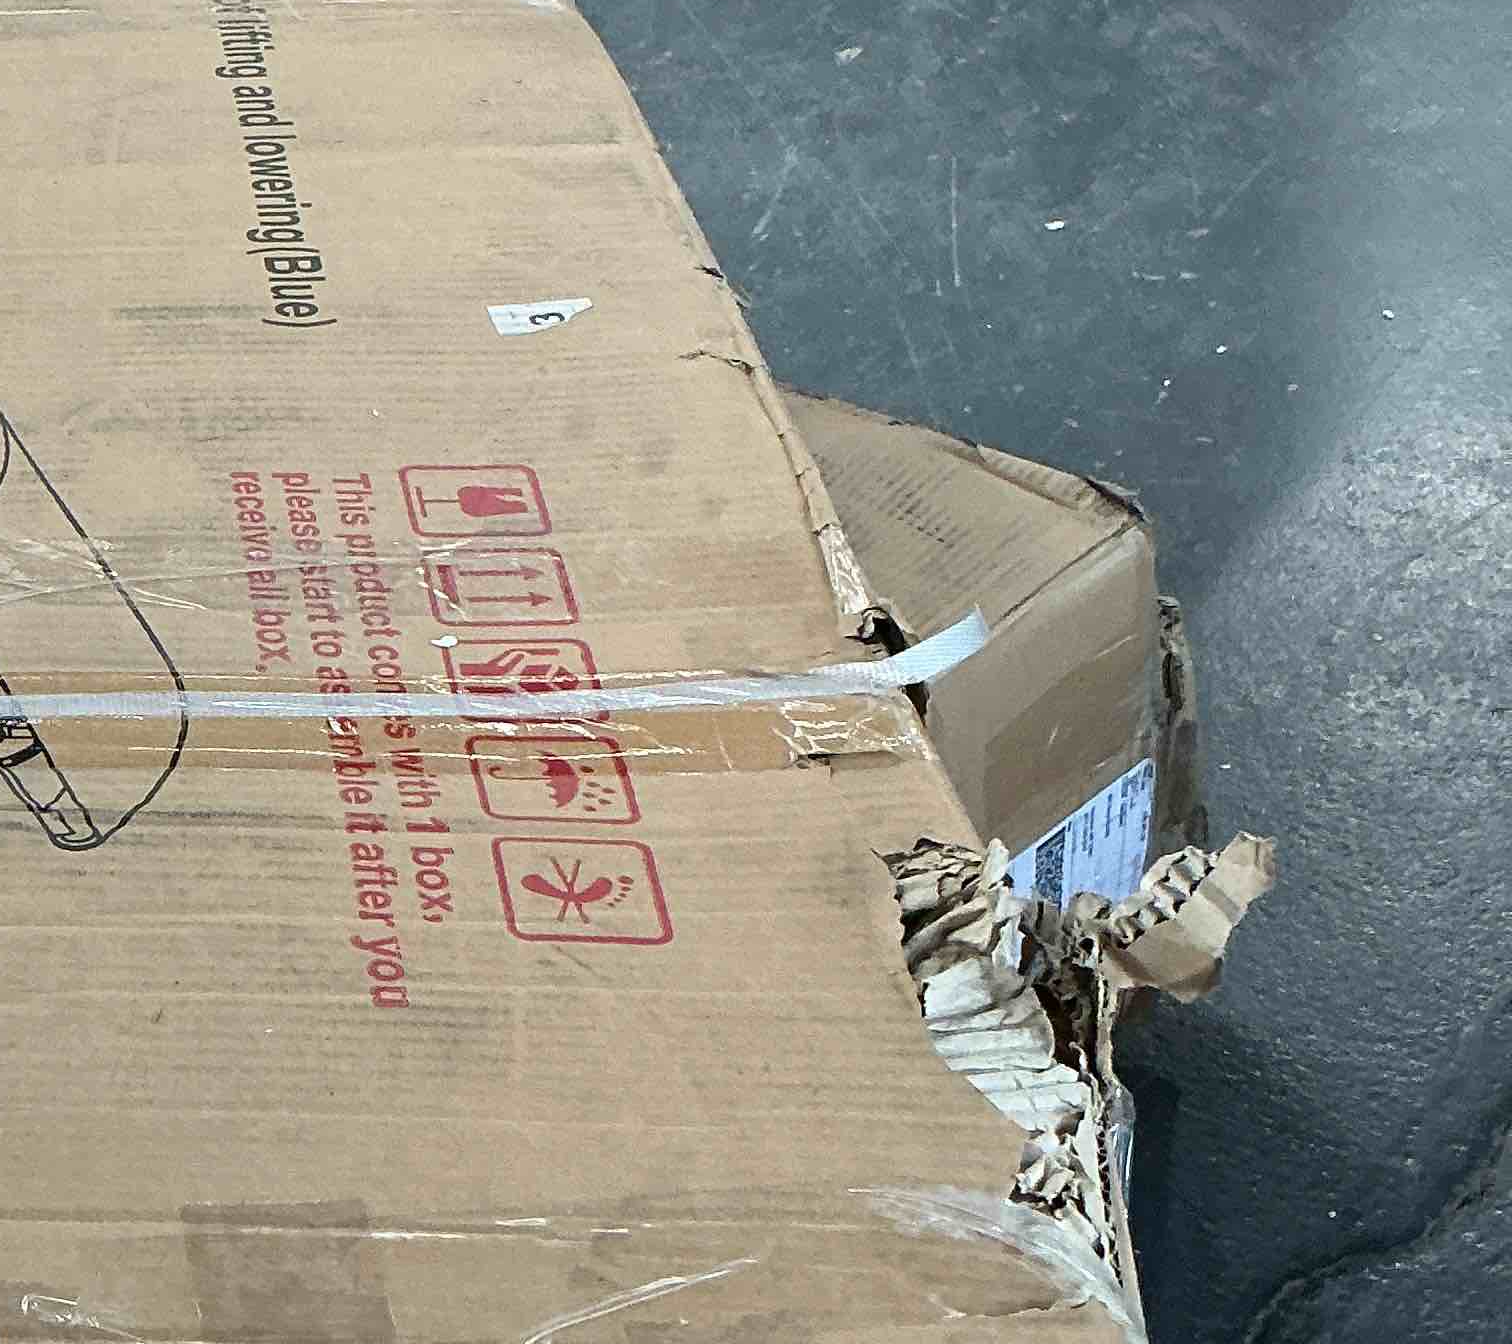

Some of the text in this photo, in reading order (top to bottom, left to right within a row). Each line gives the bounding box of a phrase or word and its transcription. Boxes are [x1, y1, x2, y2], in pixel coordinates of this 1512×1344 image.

[215, 19, 276, 81] lifting
[232, 86, 294, 127] and
[272, 472, 323, 552] please
[332, 472, 377, 528] This
[230, 472, 292, 673] receive all box.
[300, 564, 345, 623] start
[333, 534, 403, 638] product
[310, 630, 347, 658] to
[389, 748, 441, 808] with
[345, 812, 388, 833] it
[406, 816, 450, 833] 1
[349, 843, 400, 928] after
[410, 847, 454, 924] box,
[350, 936, 409, 1008] you
